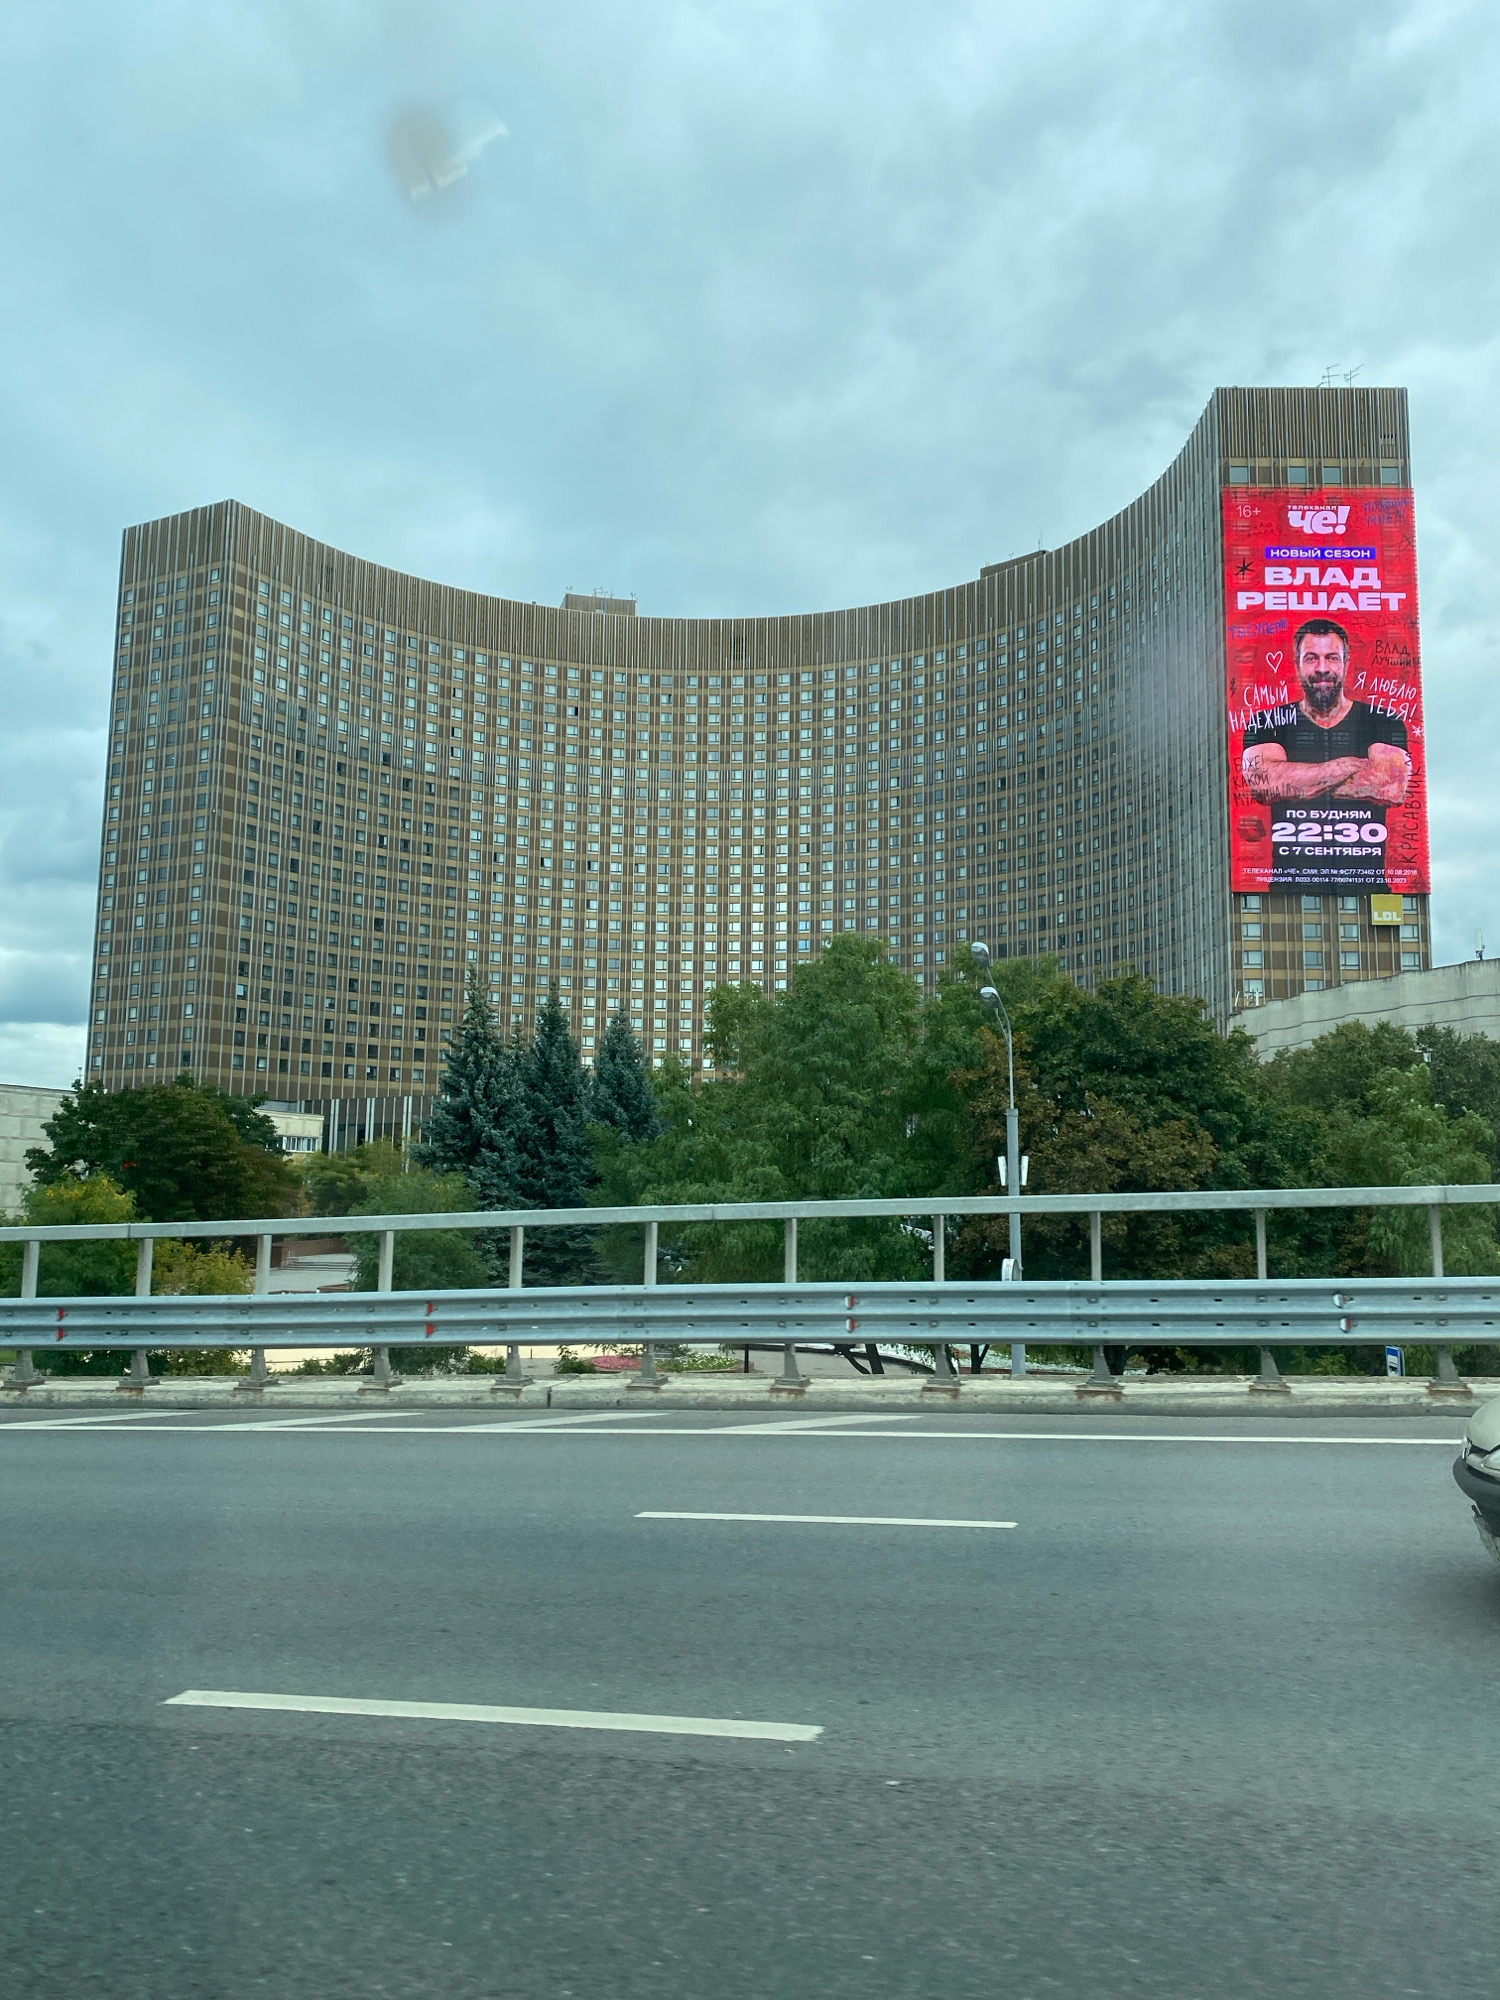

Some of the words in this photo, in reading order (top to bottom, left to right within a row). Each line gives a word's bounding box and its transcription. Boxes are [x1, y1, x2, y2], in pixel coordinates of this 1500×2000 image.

[1236, 505, 1262, 518] 16+
[1270, 548, 1321, 558] НОВЫЙ
[1324, 549, 1371, 558] СЕЗОН
[1264, 566, 1382, 589] ВЛАД
[1237, 591, 1406, 611] РЕШАЕТ
[1375, 639, 1411, 656] ВЛАД
[1243, 680, 1289, 707] САМЫЙ
[1353, 671, 1367, 690] Я
[1369, 676, 1417, 701] ЛЮБЛЮ
[1367, 695, 1417, 723] ТЕБЯ!
[1232, 770, 1270, 790] КАКОЙ
[1286, 809, 1307, 819] ПО
[1310, 810, 1372, 820] БУДНЯМ
[1400, 766, 1422, 864] КРАСАВЧИК
[1271, 821, 1388, 843] 22:30
[1278, 846, 1290, 856] С
[1292, 847, 1302, 856] 7
[1304, 847, 1382, 856] СЕНТЯБРЯ
